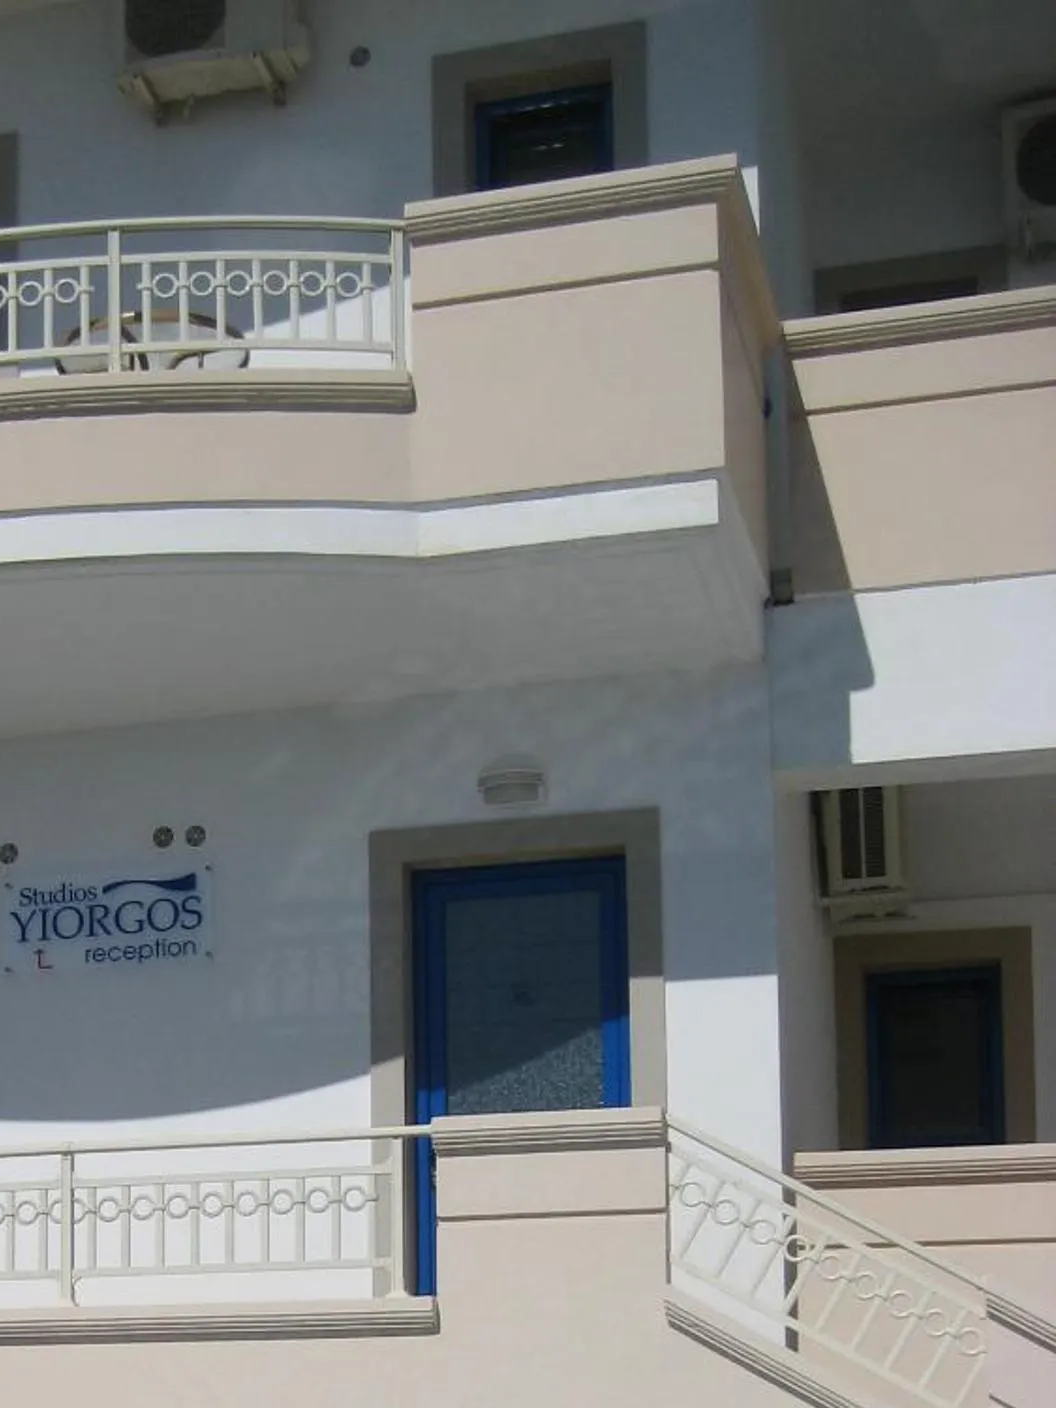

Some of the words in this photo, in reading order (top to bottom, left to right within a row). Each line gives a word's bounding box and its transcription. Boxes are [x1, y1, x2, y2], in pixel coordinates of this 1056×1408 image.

[19, 882, 98, 907] Studios
[10, 895, 203, 943] YIORGOS
[85, 938, 197, 963] reception
